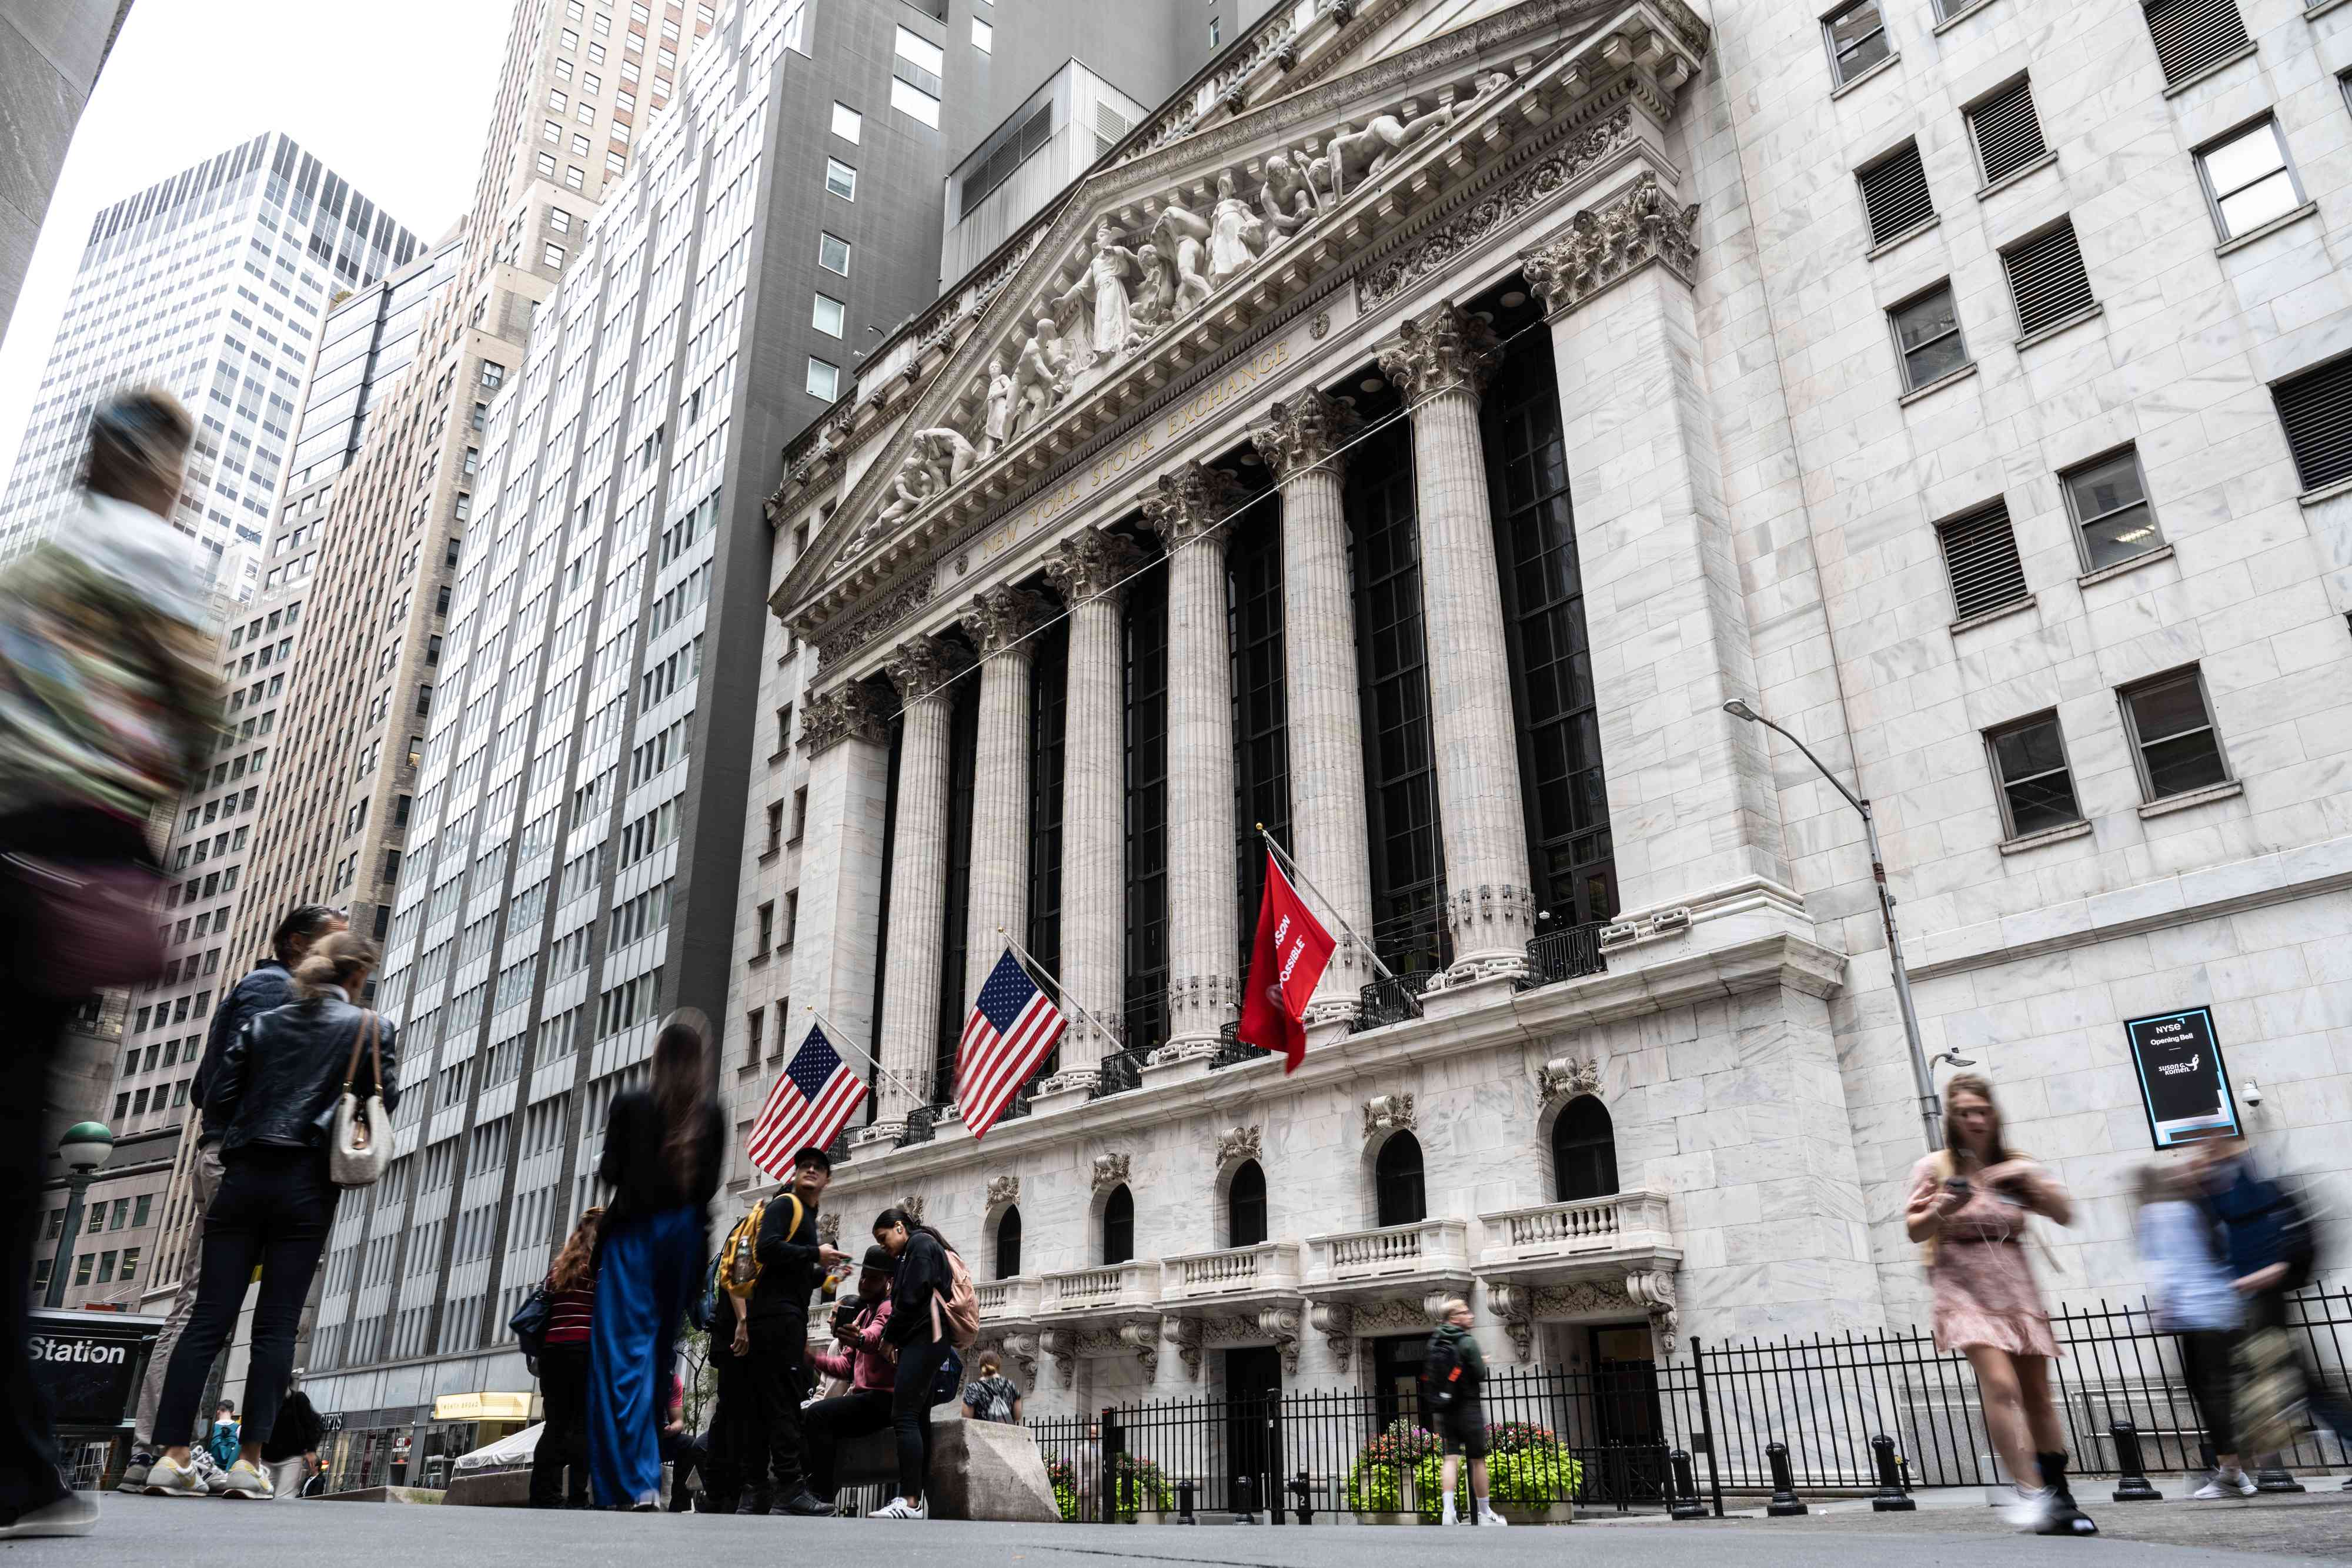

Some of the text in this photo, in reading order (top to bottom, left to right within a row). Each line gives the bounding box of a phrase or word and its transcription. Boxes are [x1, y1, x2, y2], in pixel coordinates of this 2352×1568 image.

[983, 339, 1289, 560] NEW YORK STOCK EXCHANGE
[2150, 1037, 2180, 1045] Opening
[28, 1336, 125, 1364] Station
[1300, 1496, 1305, 1506] 2
